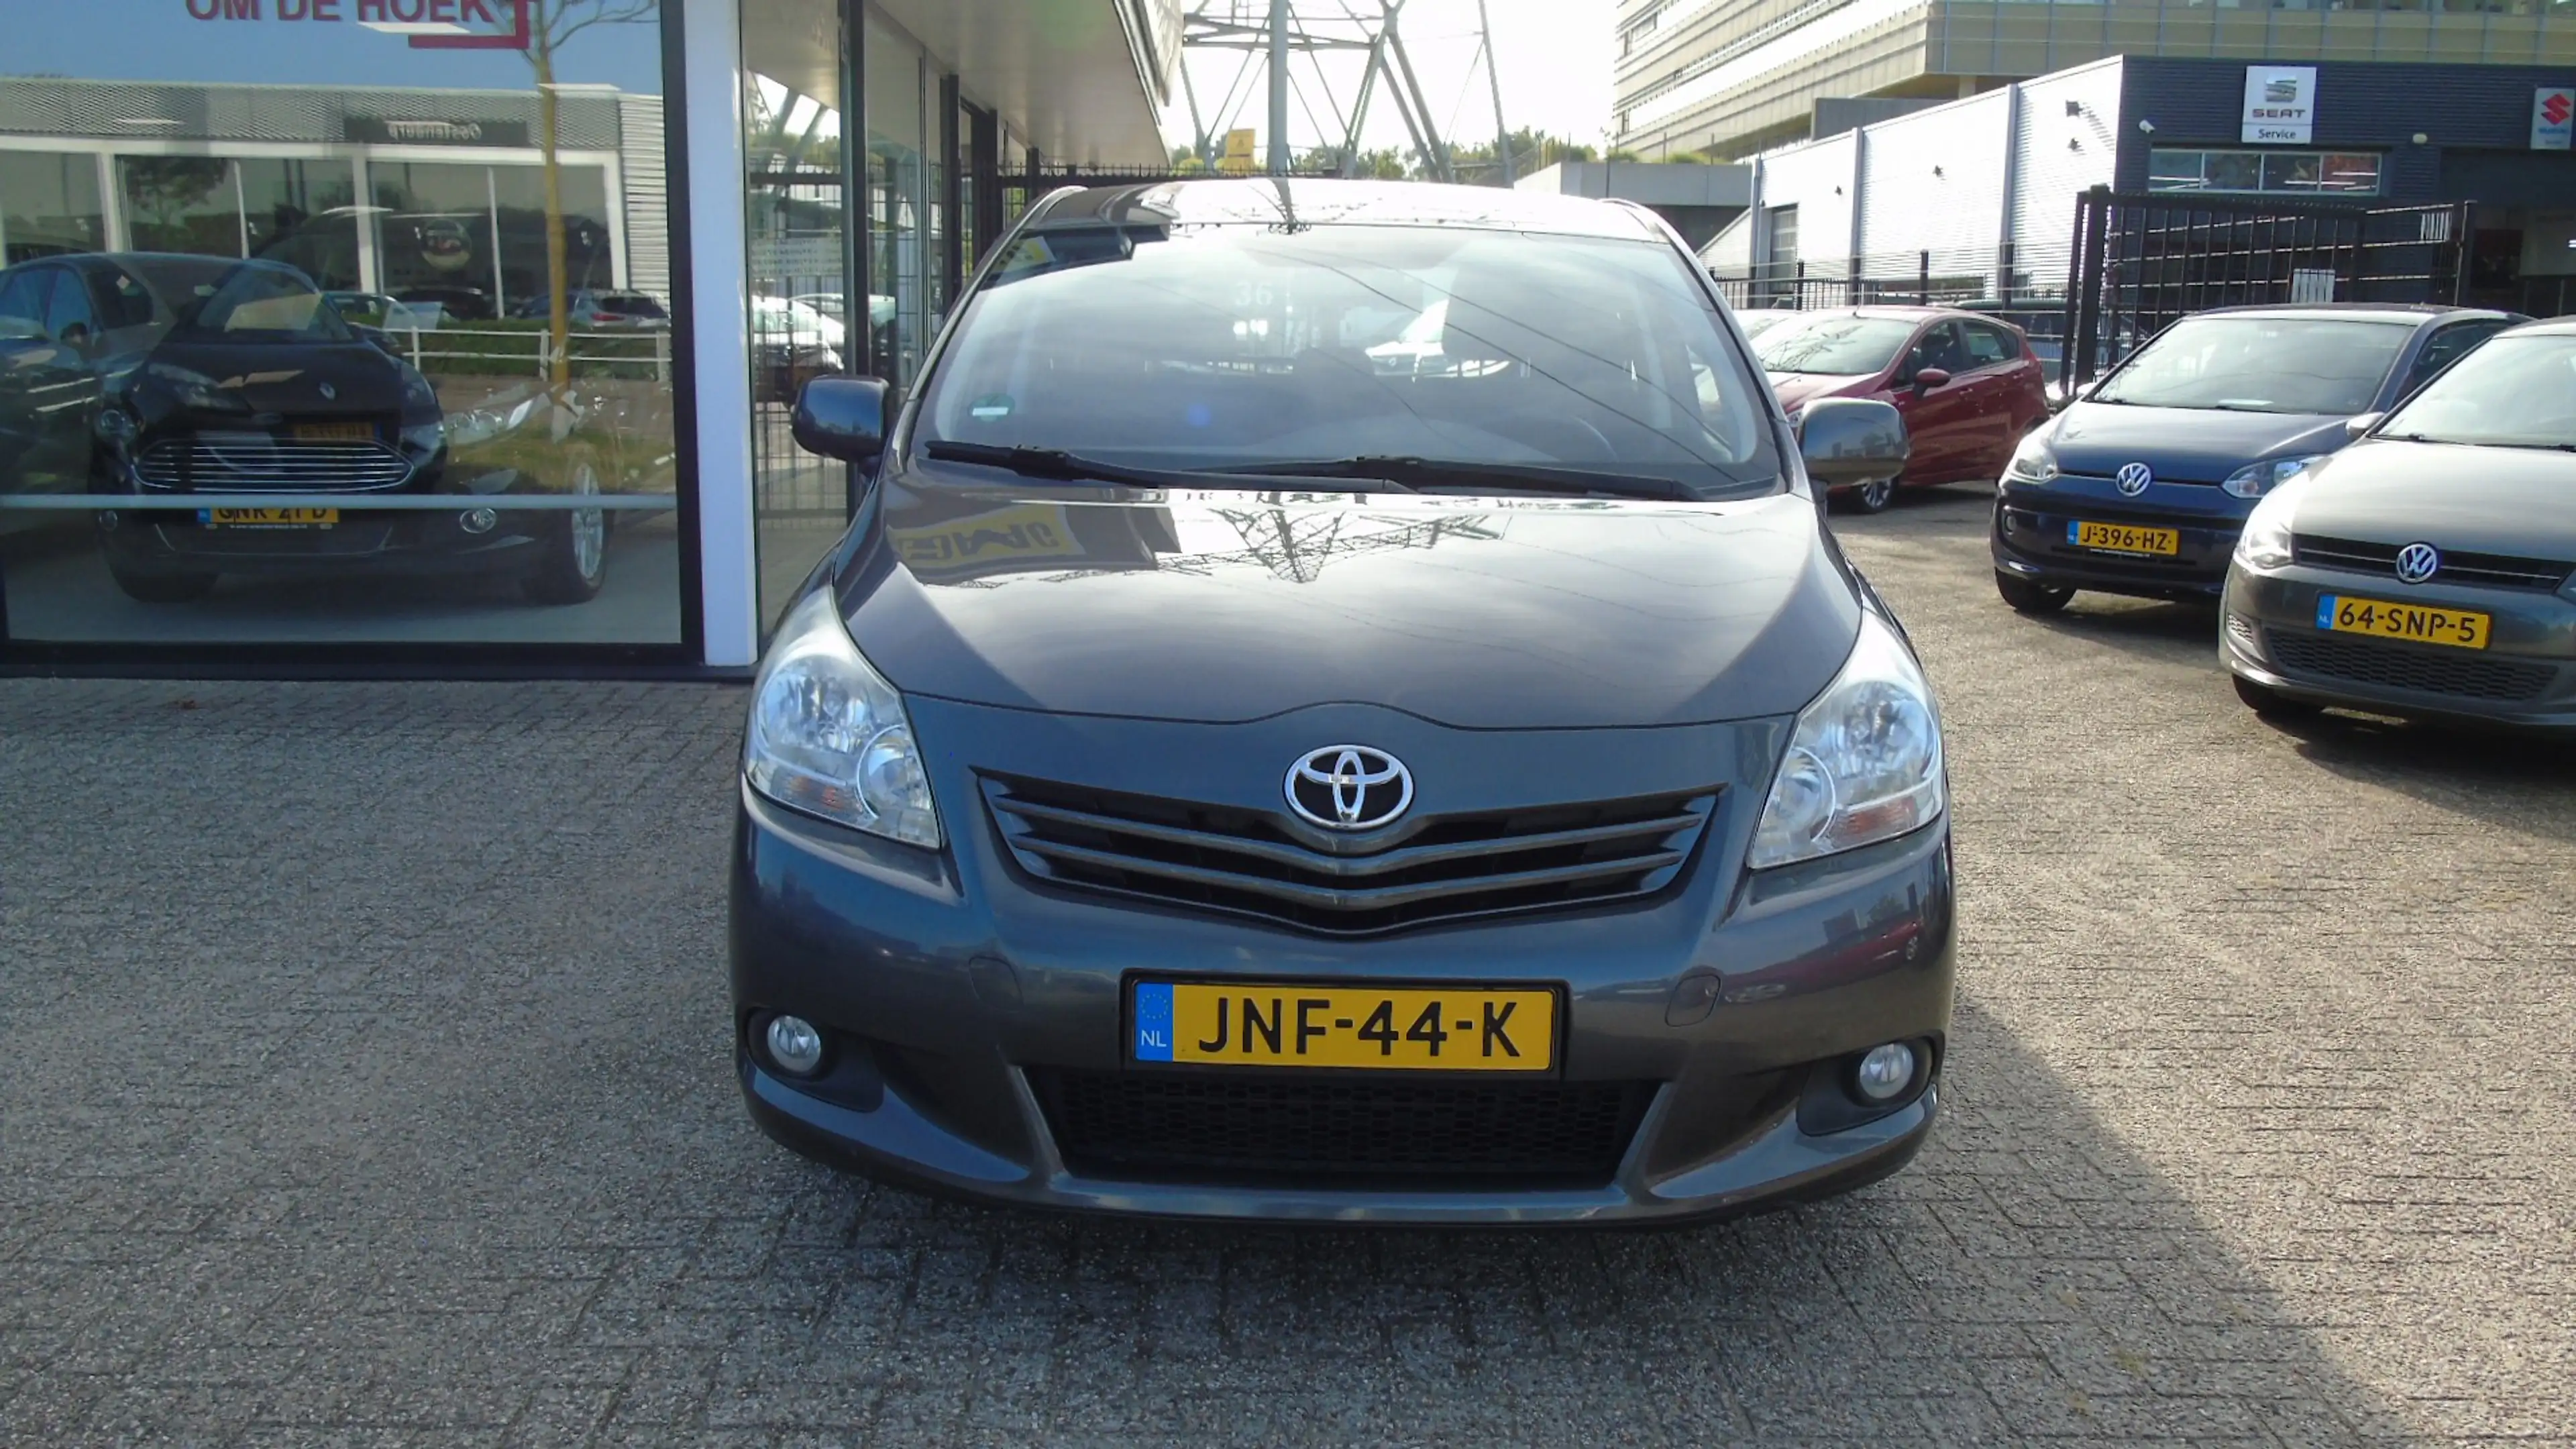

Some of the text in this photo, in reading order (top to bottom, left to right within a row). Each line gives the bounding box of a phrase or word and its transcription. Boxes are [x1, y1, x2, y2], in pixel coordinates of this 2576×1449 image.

[277, 0, 342, 21] DE
[357, 0, 495, 23] HOEK
[2252, 109, 2306, 118] SEAT
[2258, 129, 2297, 140] Service
[2082, 526, 2168, 550] J-396-HZ
[2339, 603, 2475, 642] 64-SNP-5
[1140, 997, 1520, 1057] NL JNF-44-K
